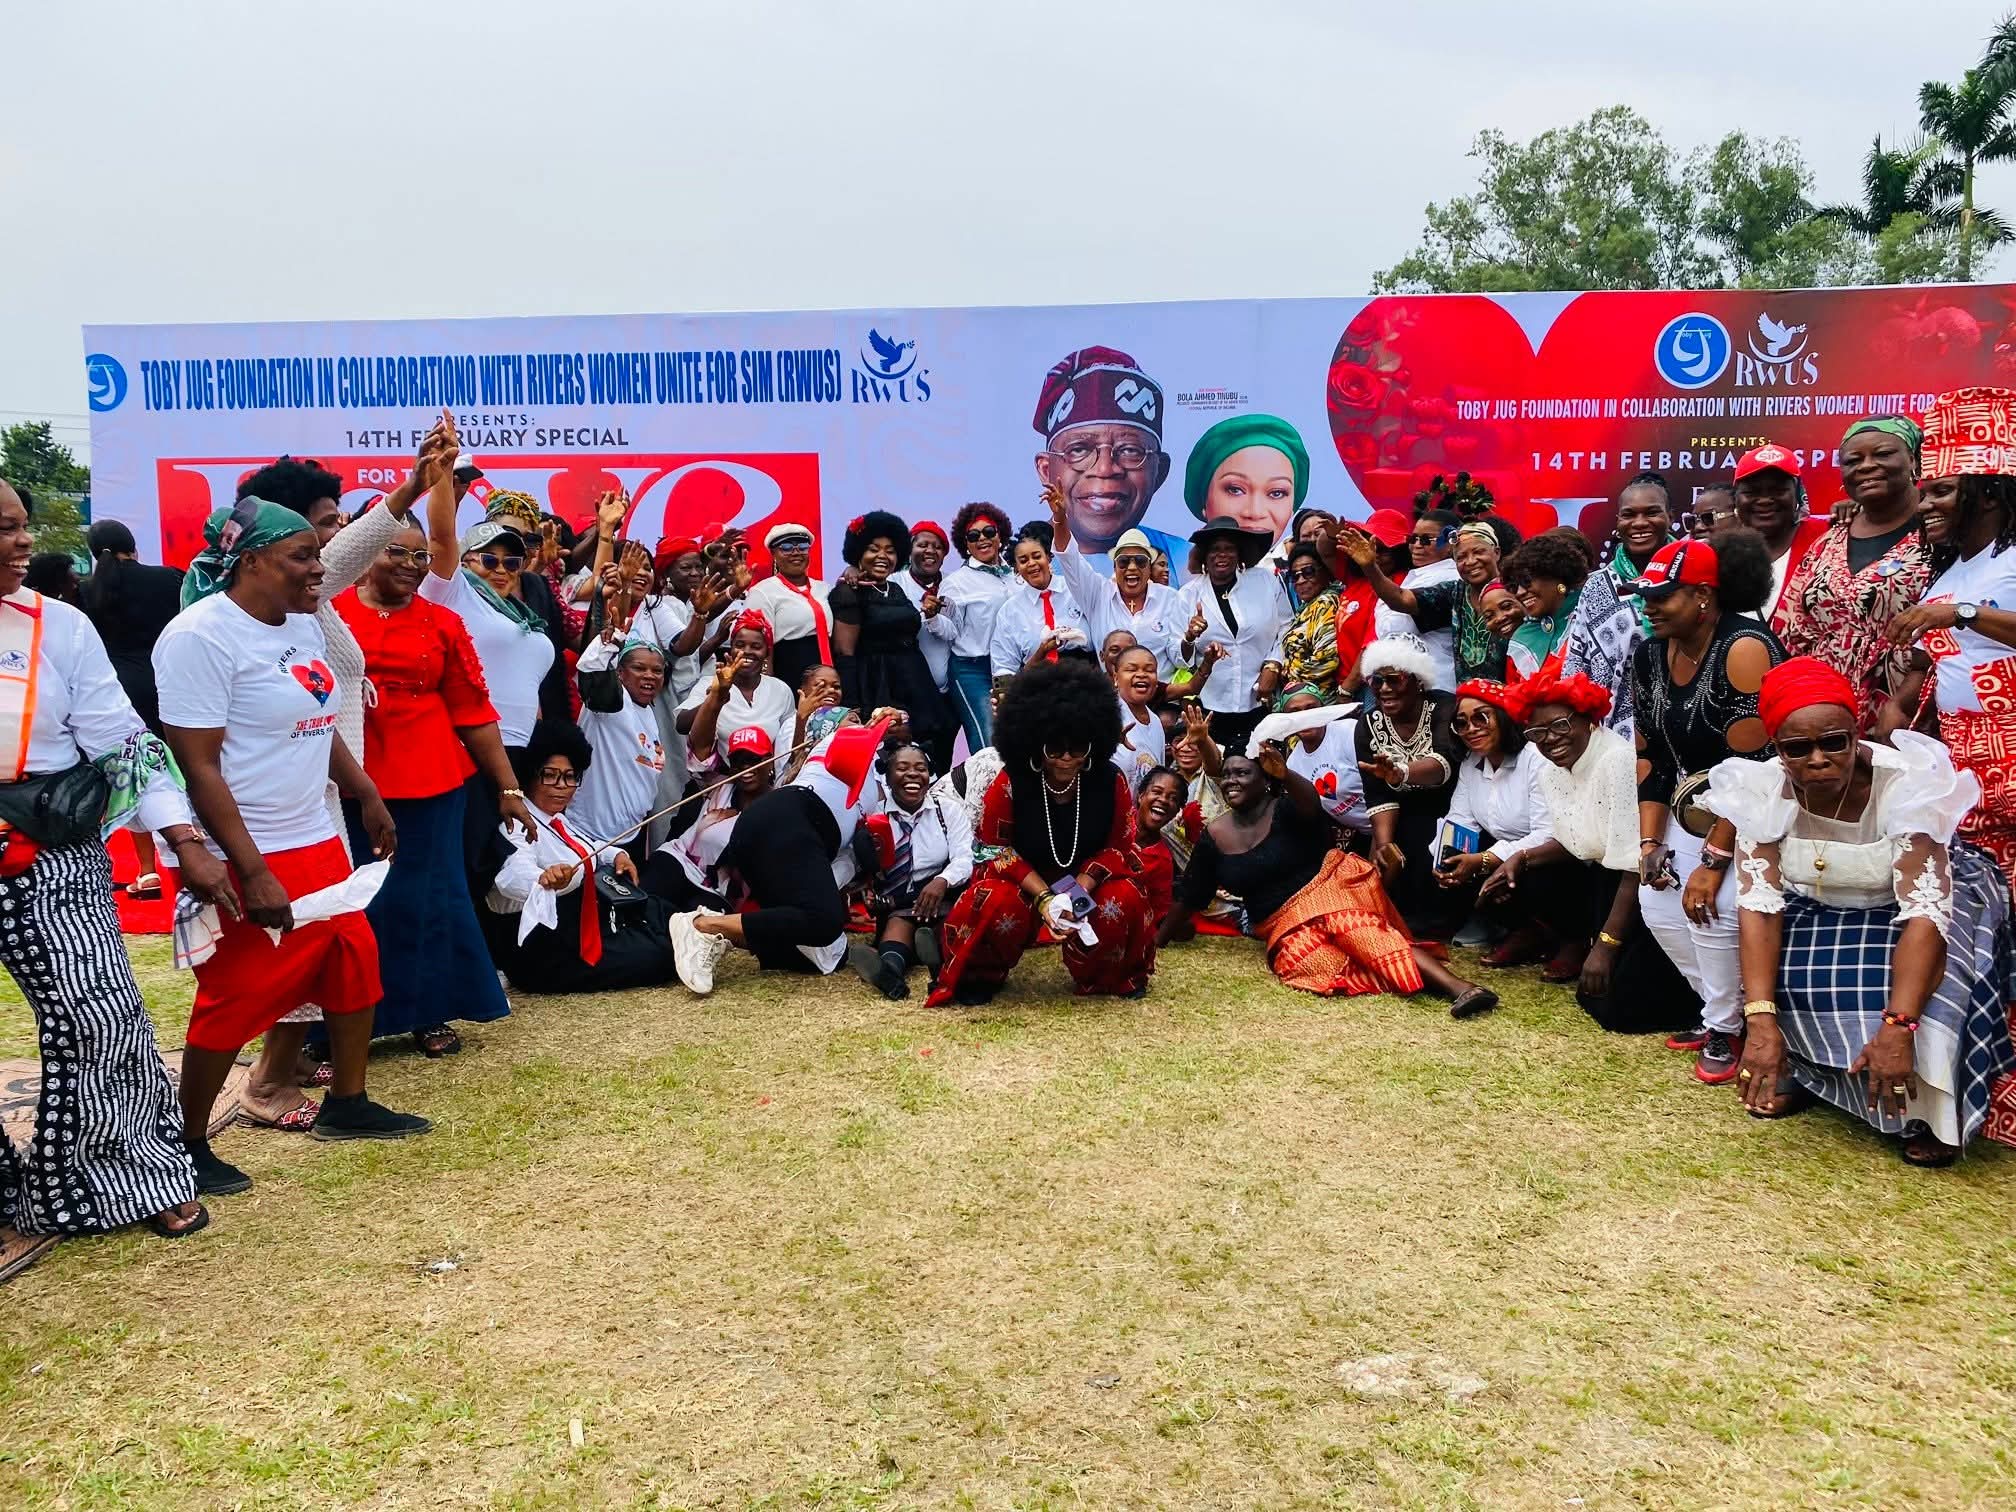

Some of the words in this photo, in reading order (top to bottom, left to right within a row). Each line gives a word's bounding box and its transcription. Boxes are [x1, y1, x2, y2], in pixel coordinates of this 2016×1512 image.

[139, 359, 182, 411] TOBY
[185, 358, 215, 410] JUG
[216, 357, 315, 409] FOUNDATION
[317, 357, 335, 408] IN
[337, 354, 477, 408] COLLABORATIONO
[479, 354, 524, 406] WITH
[526, 352, 586, 405] RIVERS
[587, 351, 653, 405] WOMEN
[655, 351, 703, 404] UNITE
[706, 350, 738, 404] FOR
[741, 349, 774, 403] SIM
[1734, 351, 1819, 387] RWUS
[852, 369, 931, 403] RWUS
[1457, 400, 1490, 420] TOBY
[1493, 399, 1517, 419] JUG
[1521, 398, 1600, 419] FOUNDATION
[1604, 398, 1617, 418] IN
[1621, 397, 1724, 418] COLLABORATION
[1729, 396, 1761, 417] WITH
[1765, 395, 1810, 416] RIVERS
[1815, 394, 1864, 415] WOMEN
[1868, 393, 1905, 414] UNITE
[346, 430, 402, 449] 14TH
[536, 427, 629, 447] SPECIAL
[1532, 452, 1607, 470] 14TH
[357, 468, 396, 484] FOR
[732, 730, 758, 745] SIM
